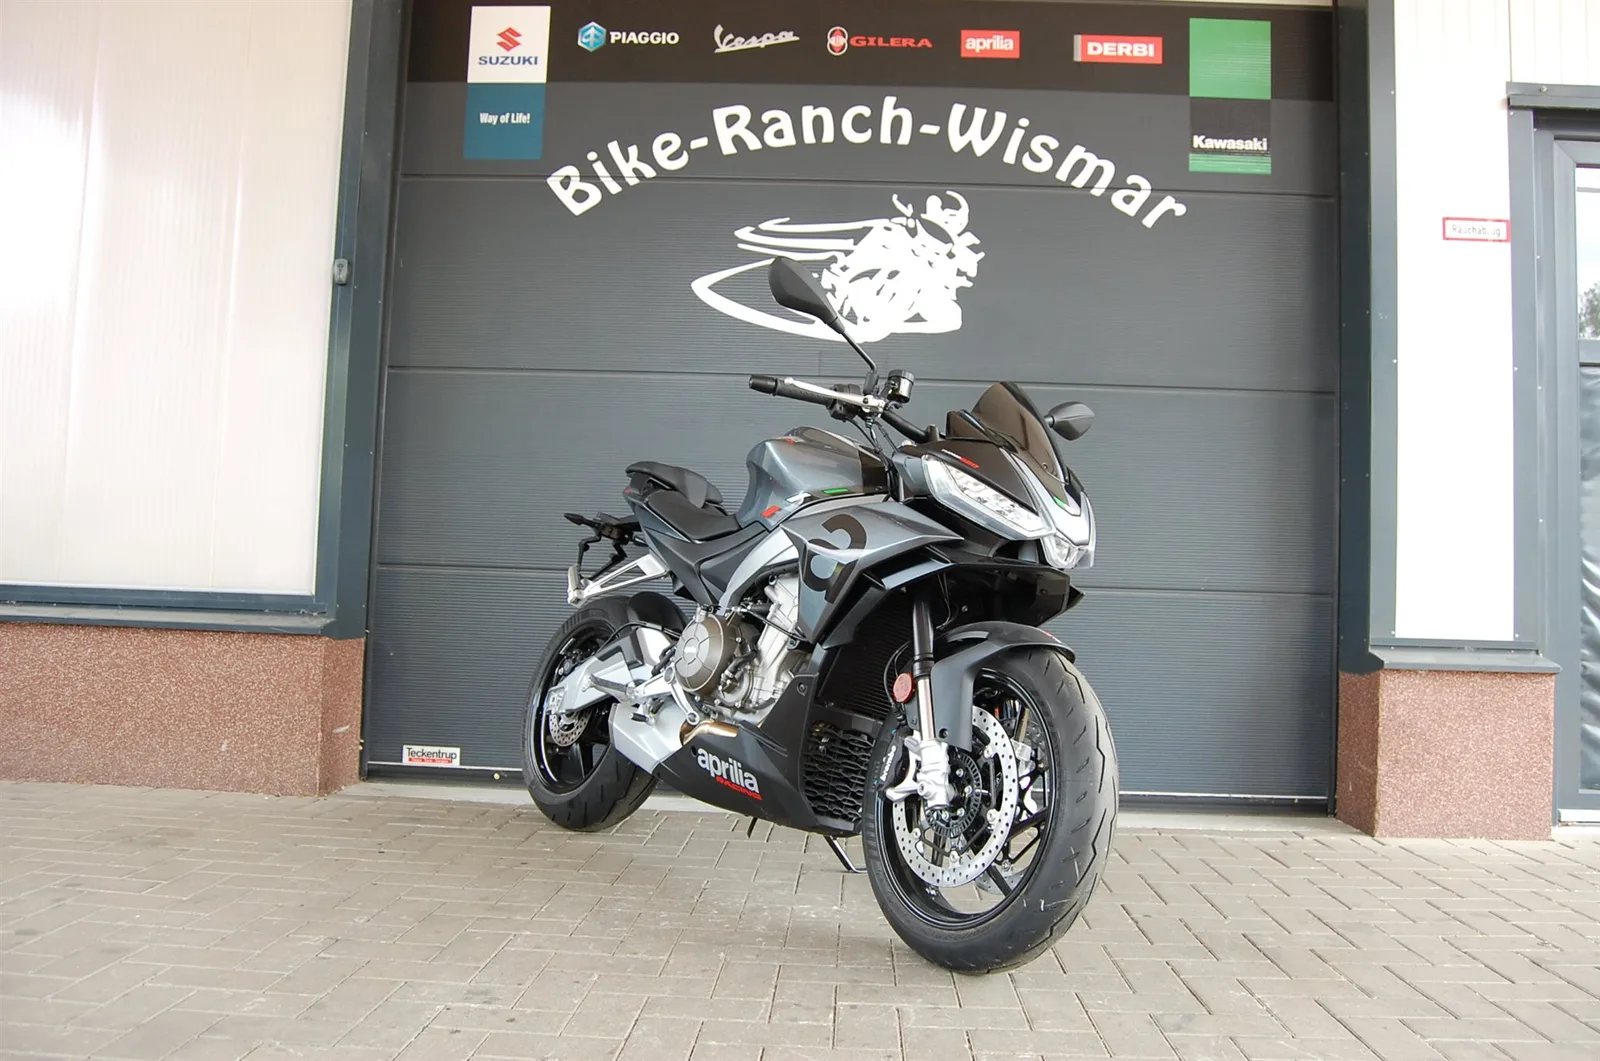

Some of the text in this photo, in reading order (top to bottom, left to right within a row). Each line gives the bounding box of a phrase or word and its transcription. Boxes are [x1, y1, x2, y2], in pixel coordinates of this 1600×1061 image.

[609, 31, 680, 45] PIAGGIO
[713, 24, 800, 54] Vespa
[849, 35, 933, 48] GILERA
[965, 35, 1014, 52] aprilia
[1087, 41, 1155, 57] DERBI
[478, 55, 538, 66] SUZUKI
[480, 112, 531, 125] Way of Life!
[1192, 134, 1268, 151] Kawasaki
[1452, 224, 1501, 237] Rauchabug
[406, 747, 457, 760] Teckentrup
[697, 747, 760, 794] aprilia
